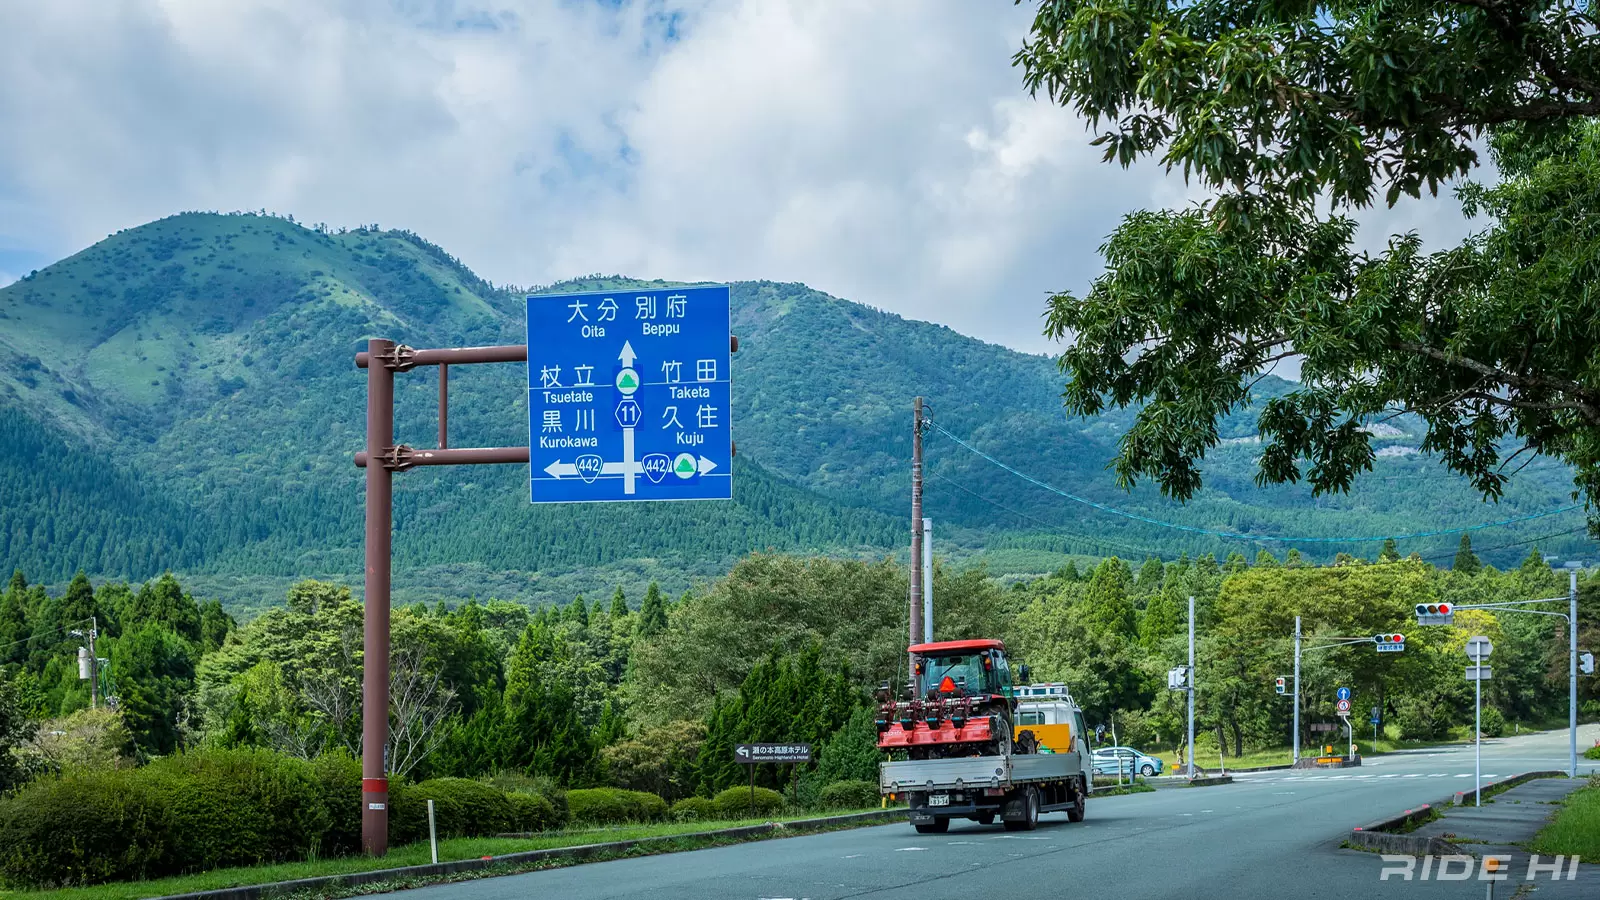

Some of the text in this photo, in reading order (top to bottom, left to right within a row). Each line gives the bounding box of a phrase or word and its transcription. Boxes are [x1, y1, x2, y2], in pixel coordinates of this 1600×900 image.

[567, 294, 688, 322] 大分 別府
[581, 322, 680, 338] Oita Beppu
[540, 363, 595, 388] 杖立
[661, 359, 717, 384] 竹田
[543, 390, 594, 404] Tsuetate
[669, 386, 710, 399] Taketa
[541, 408, 595, 433] 黒川
[620, 406, 636, 422] 11
[661, 404, 719, 429] 久住
[540, 436, 598, 449] Kurokawa
[676, 431, 704, 447] Kuju
[578, 458, 599, 472] 442
[645, 458, 666, 473] 442
